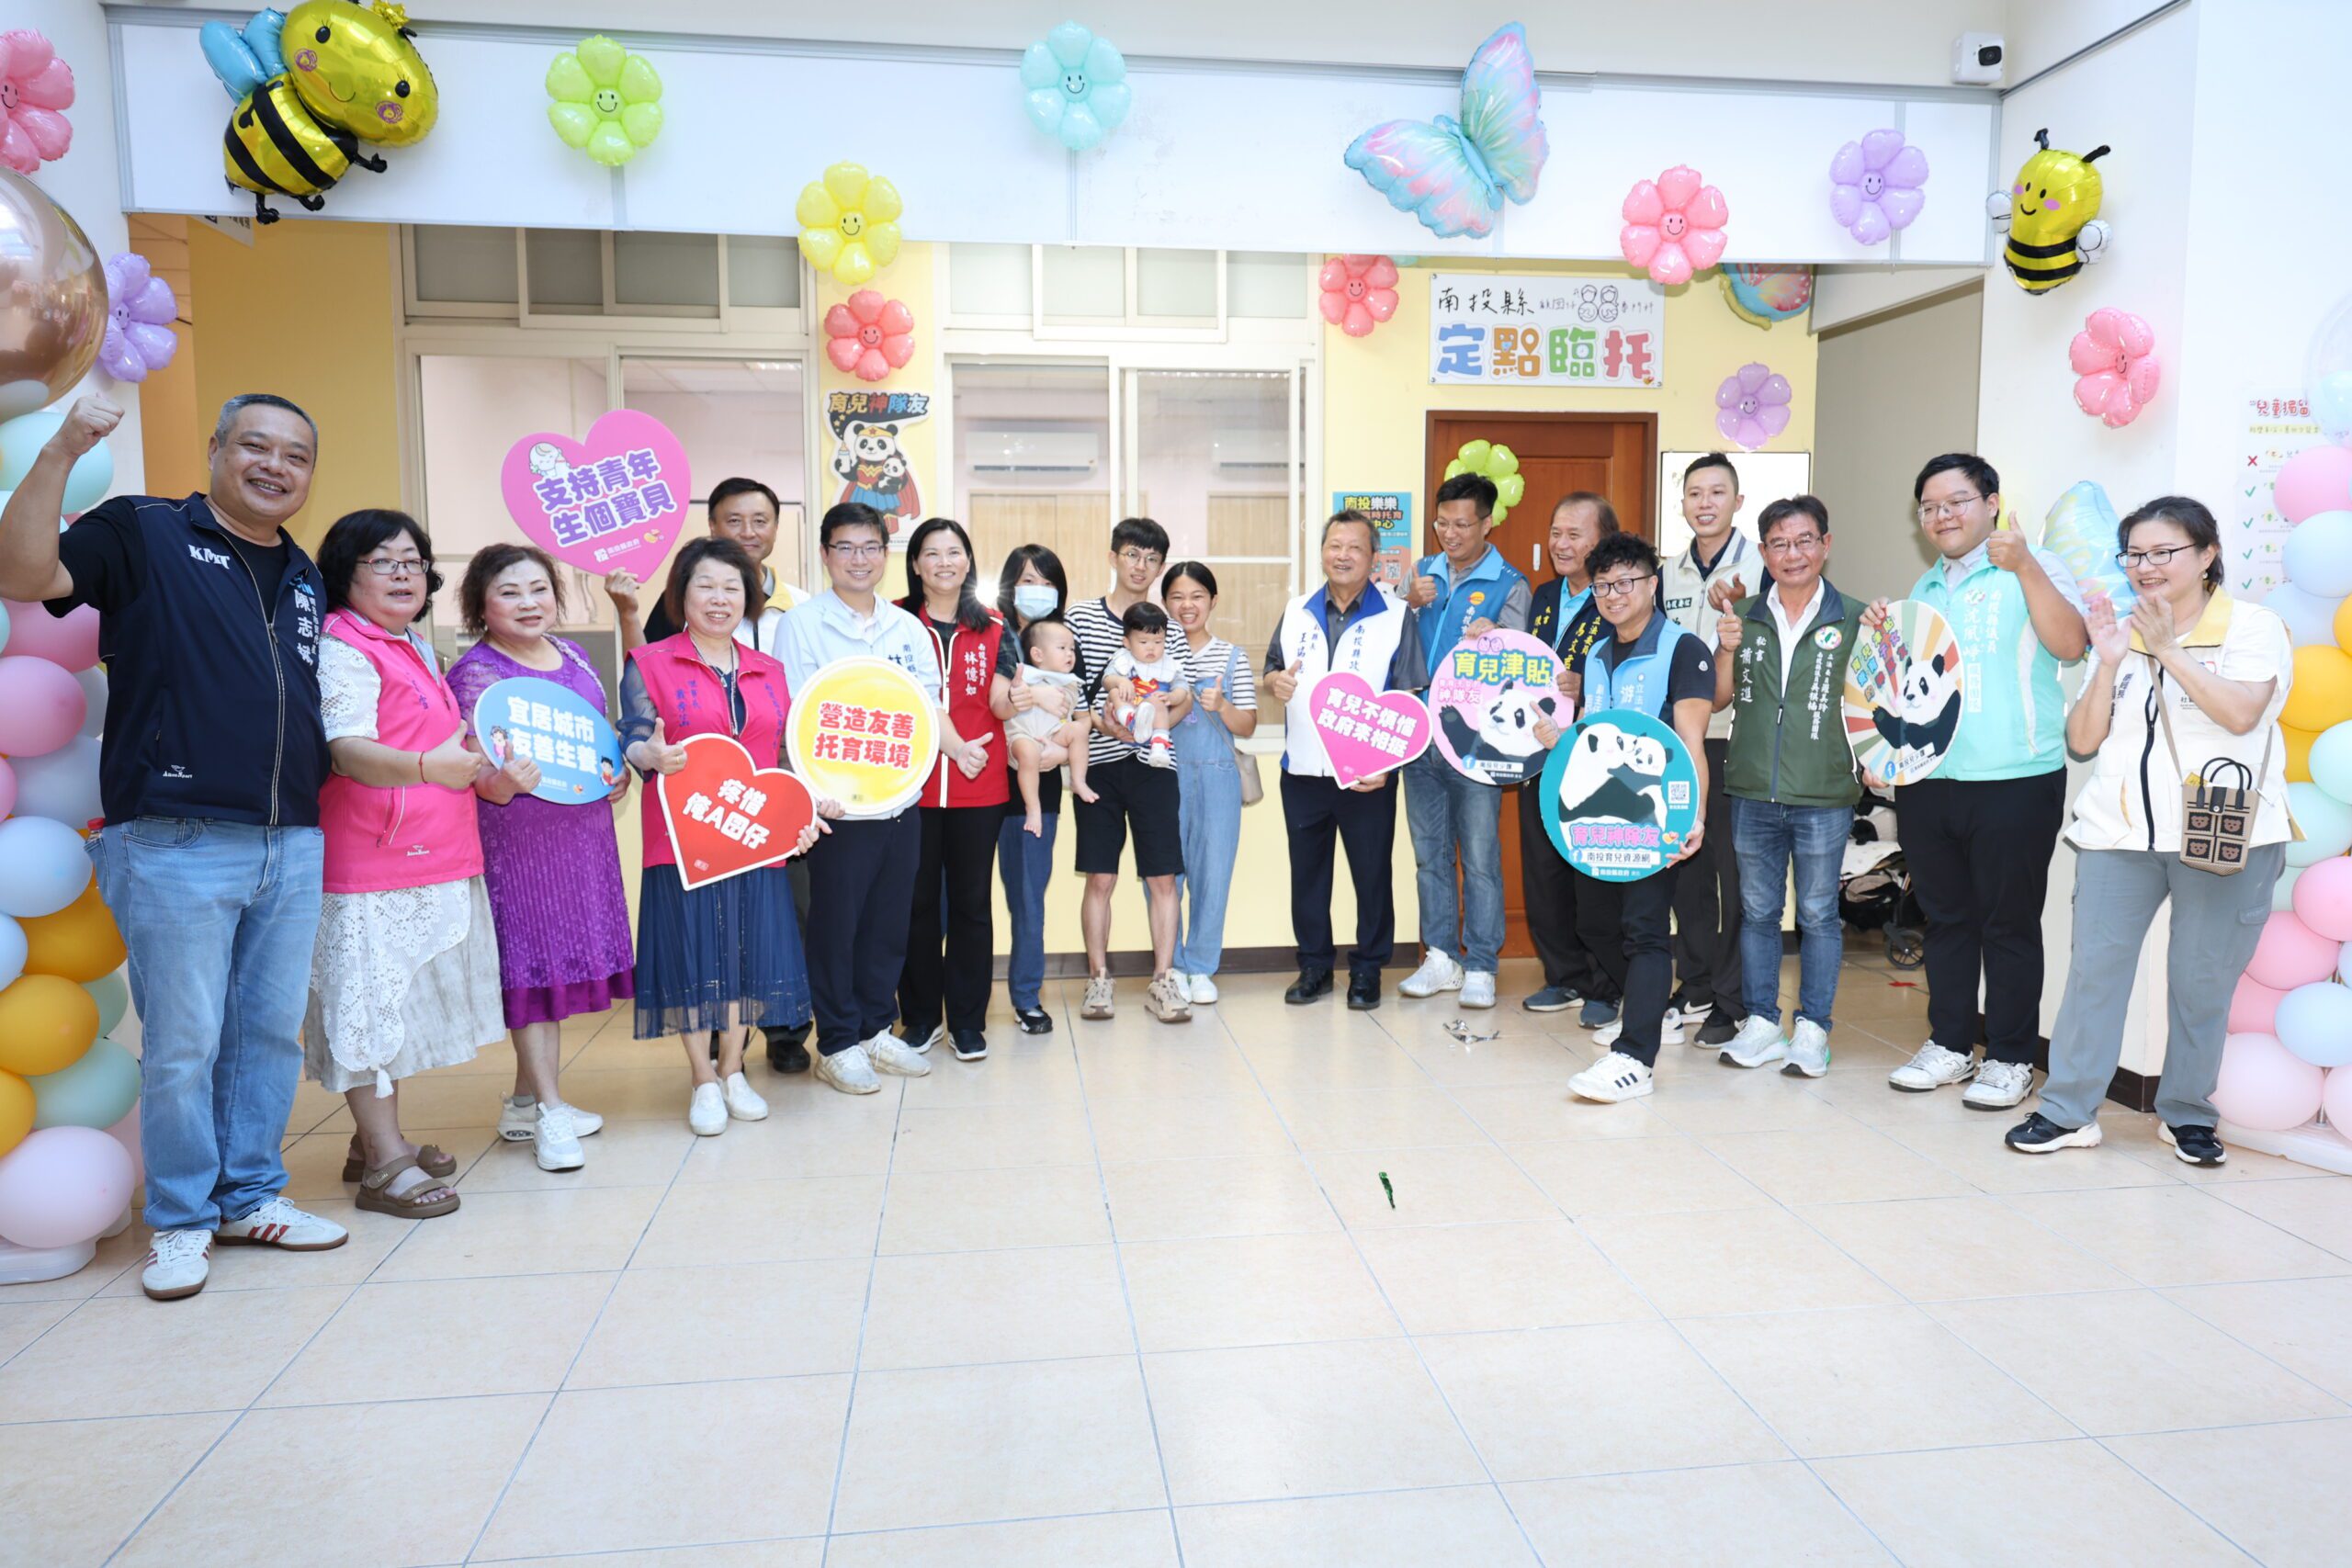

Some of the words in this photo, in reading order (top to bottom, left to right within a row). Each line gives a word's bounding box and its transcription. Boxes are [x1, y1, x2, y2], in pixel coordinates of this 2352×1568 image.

[1438, 286, 1535, 317] 南投縣
[1437, 323, 1655, 379] 定點臨托
[829, 392, 929, 414] 育兒神隊友
[534, 448, 661, 511] 支持青年
[550, 480, 677, 547] 生個寶貝
[188, 544, 231, 570] KMT
[1453, 650, 1553, 685] 育兒津貼
[507, 696, 595, 743] 宜居城市
[820, 702, 914, 739] 營造友善
[1326, 687, 1418, 738] 育兒不煩惱
[509, 728, 597, 774] 友善生養
[814, 732, 911, 769] 托育環境
[1317, 706, 1408, 759] 政府來相挺
[718, 779, 767, 817] 疼惜
[1571, 824, 1661, 848] 育兒神隊友
[1587, 852, 1651, 863] 南投育兒資源網
